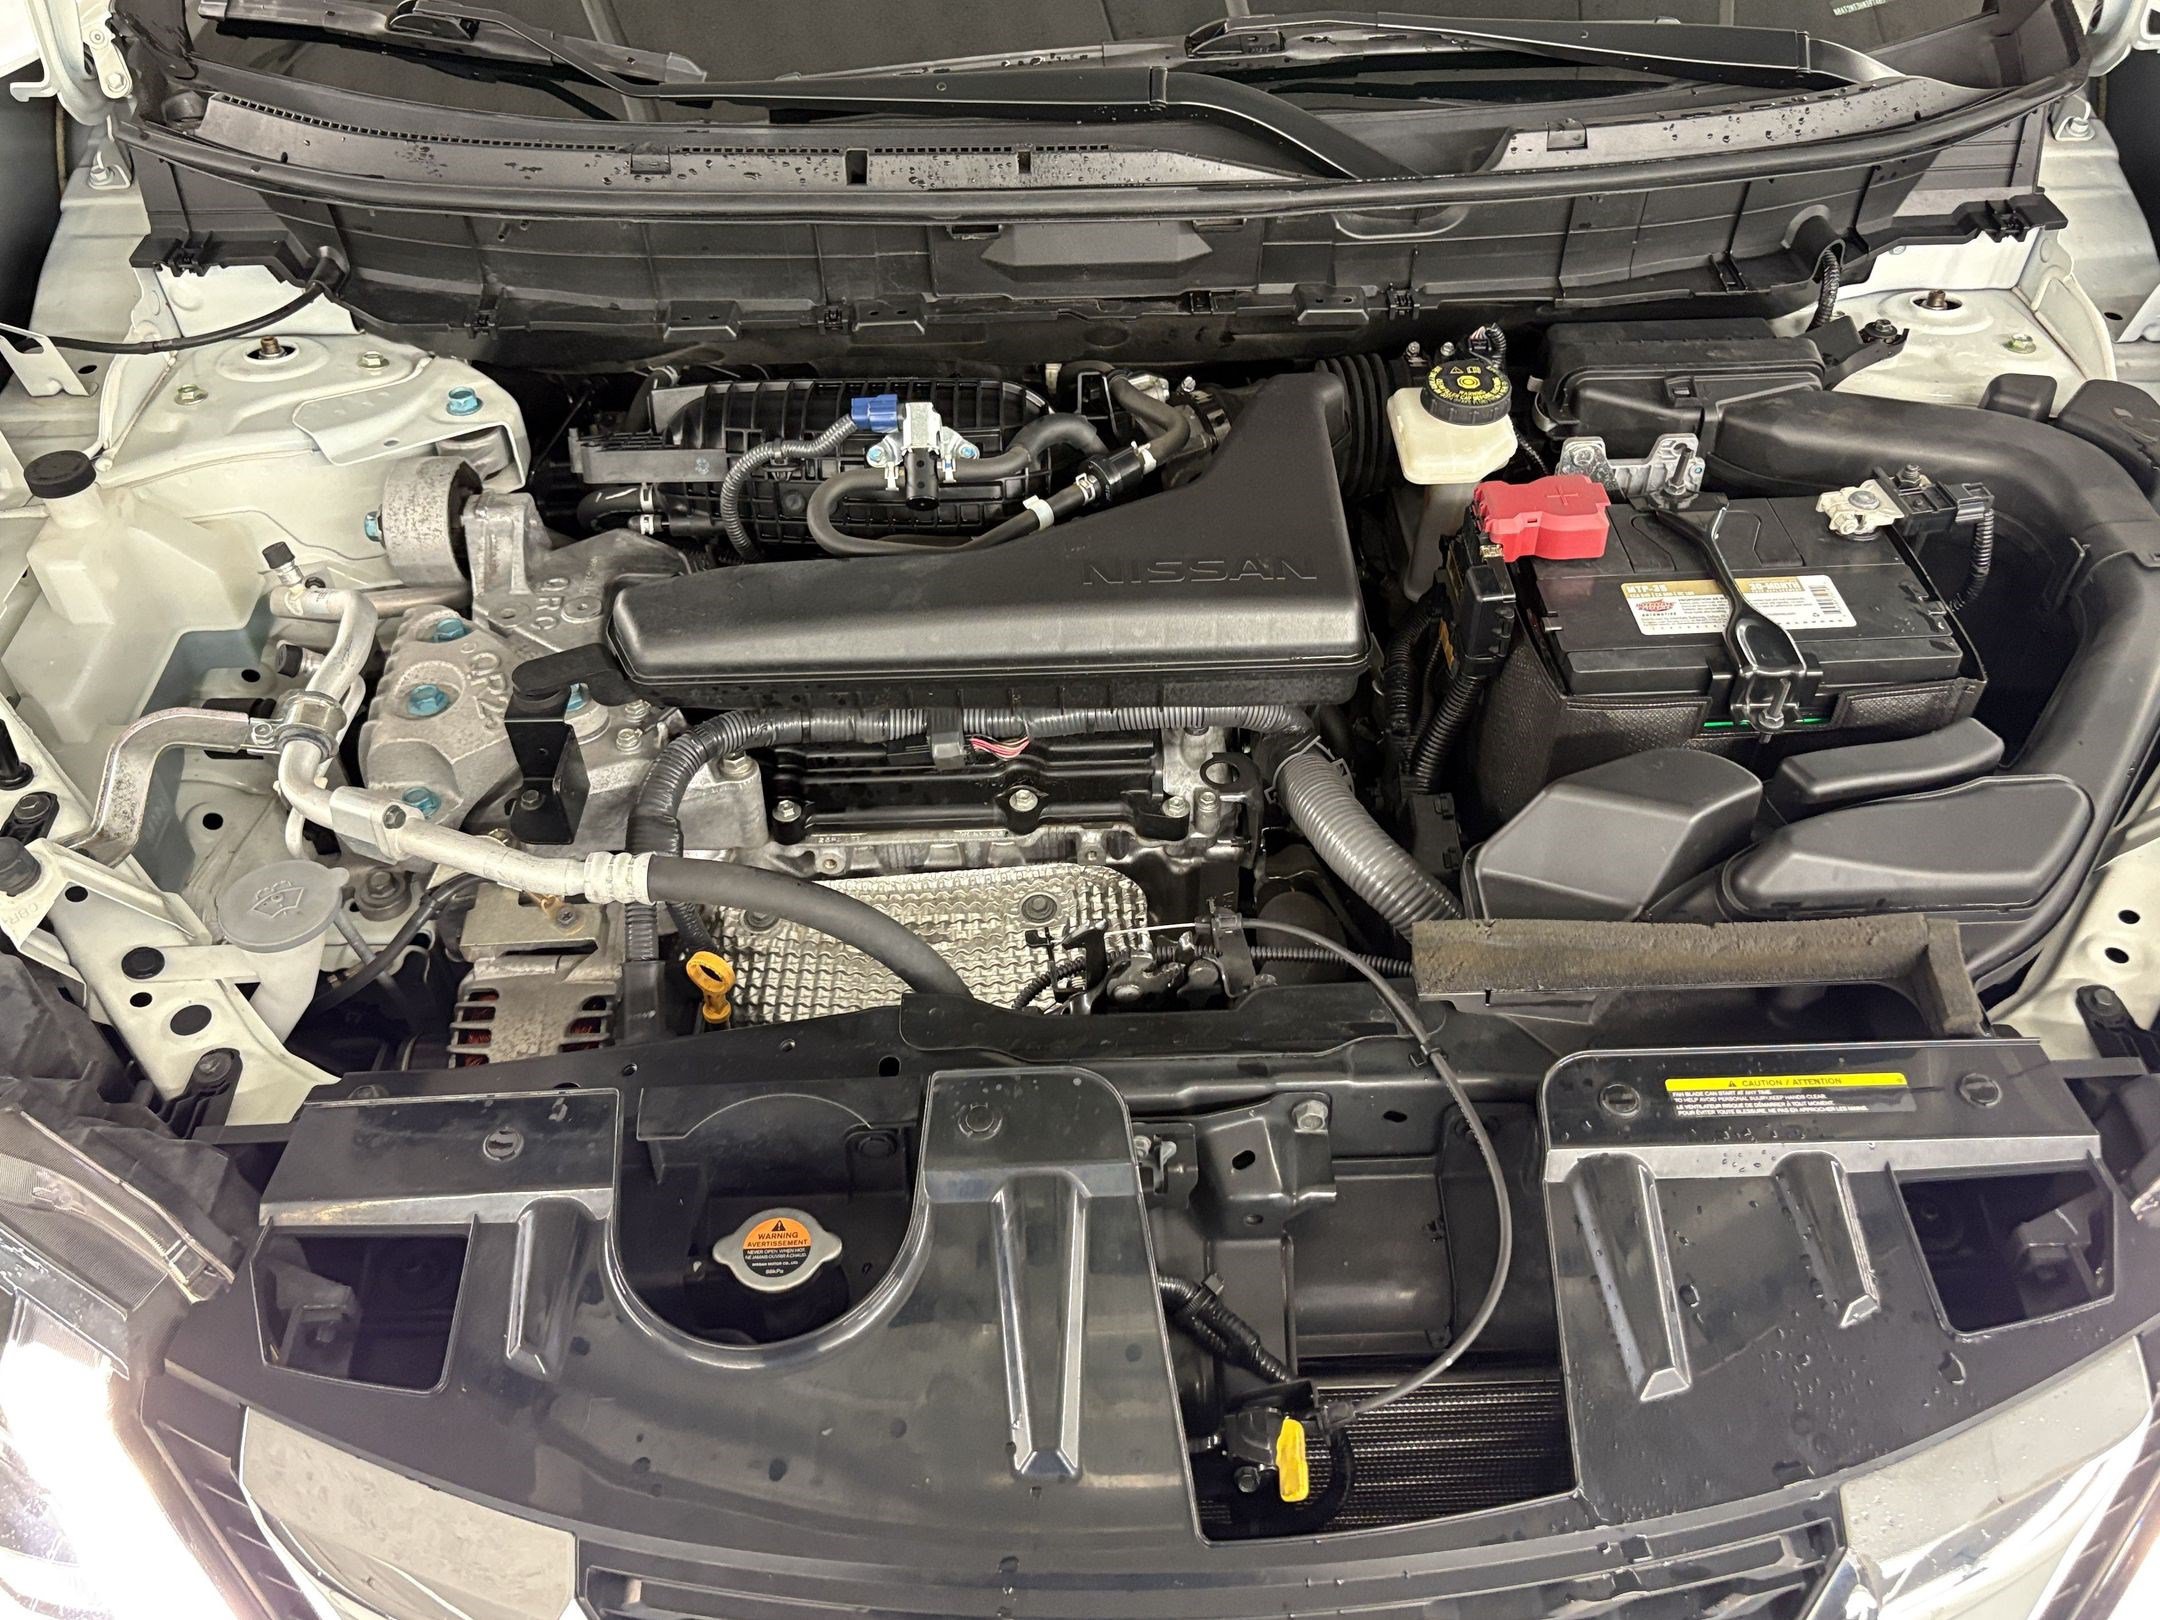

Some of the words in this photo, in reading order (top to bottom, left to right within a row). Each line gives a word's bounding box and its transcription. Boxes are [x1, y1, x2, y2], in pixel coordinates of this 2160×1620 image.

[1083, 560, 1317, 584] NISSAN
[1741, 1079, 1784, 1087] CAUTION
[1792, 1077, 1842, 1086] ATTENTION
[758, 1232, 798, 1240] WARNING
[747, 1239, 808, 1247] AVERTISSEMENT
